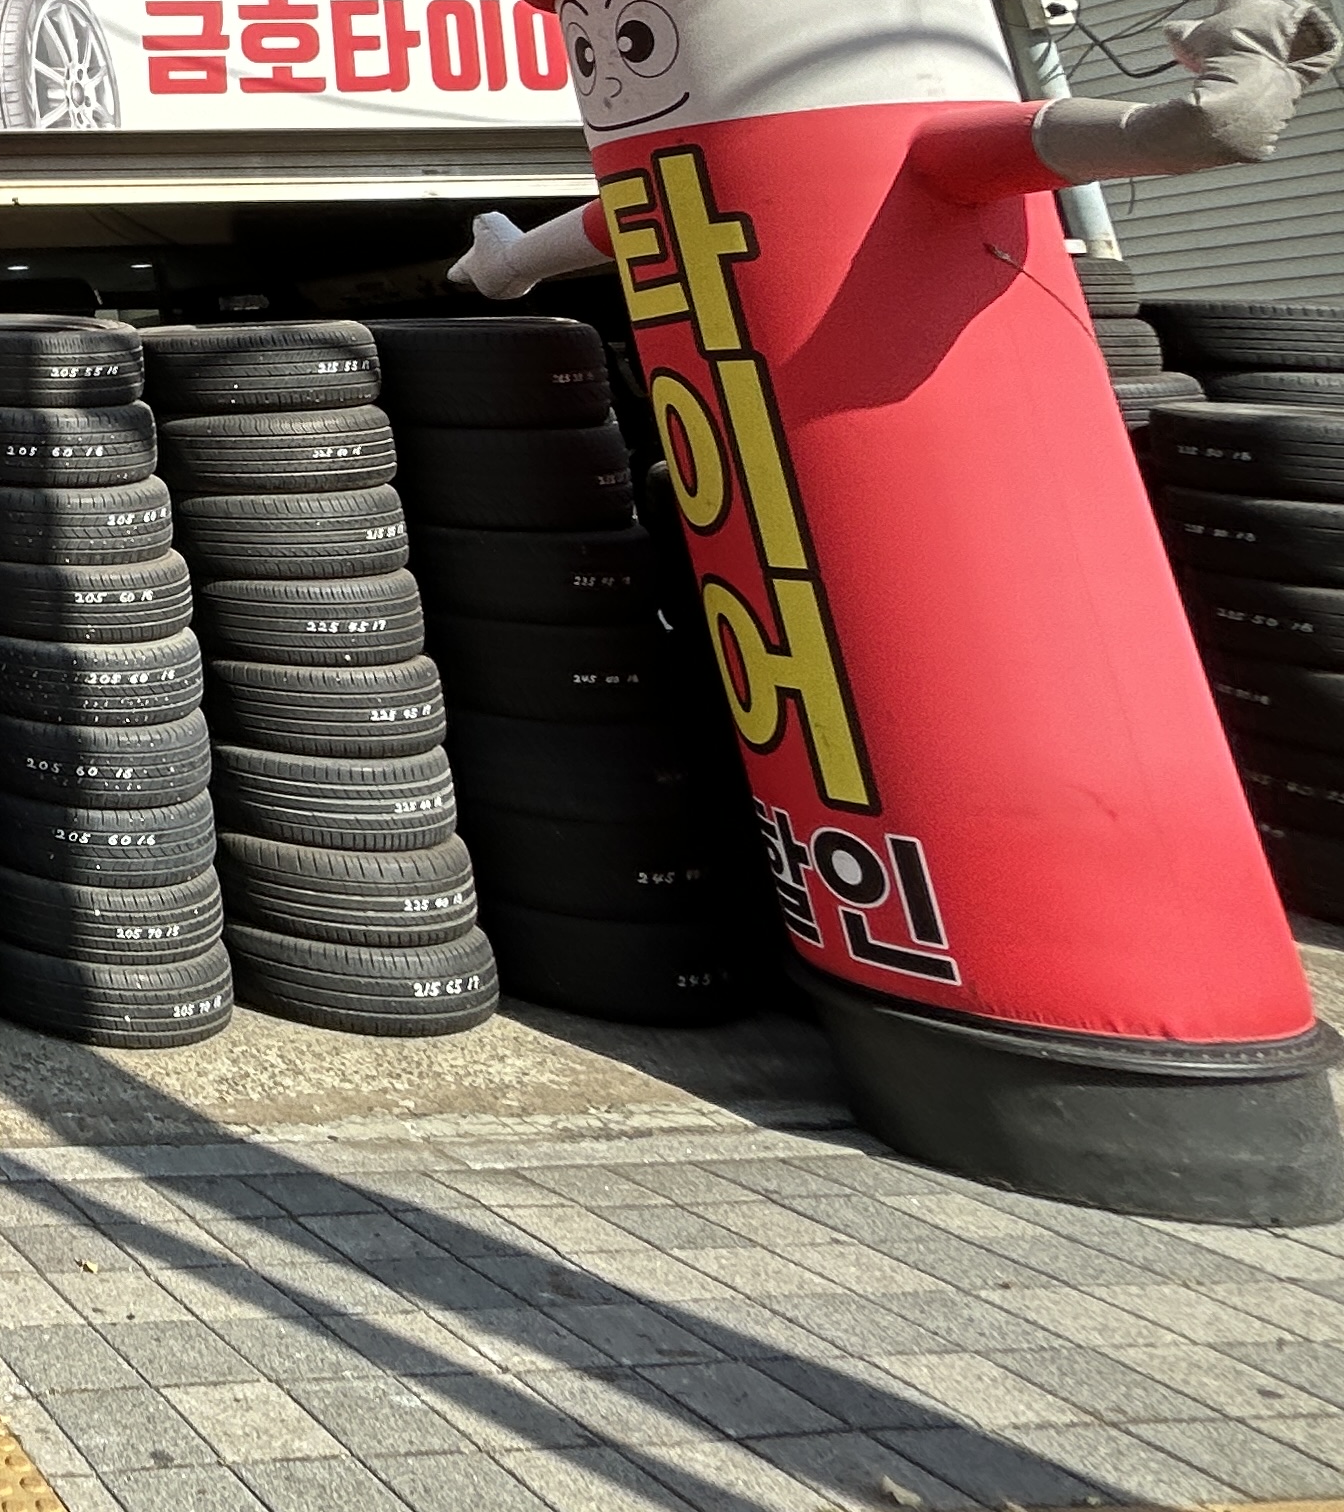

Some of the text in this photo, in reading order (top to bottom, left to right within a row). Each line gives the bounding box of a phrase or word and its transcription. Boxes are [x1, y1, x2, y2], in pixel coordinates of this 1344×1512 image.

[597, 144, 879, 814] 타이어
[25, 756, 99, 778] 205 60
[54, 828, 93, 845] 205
[107, 834, 132, 846] 60
[115, 927, 143, 940] 205
[413, 980, 442, 997] 215
